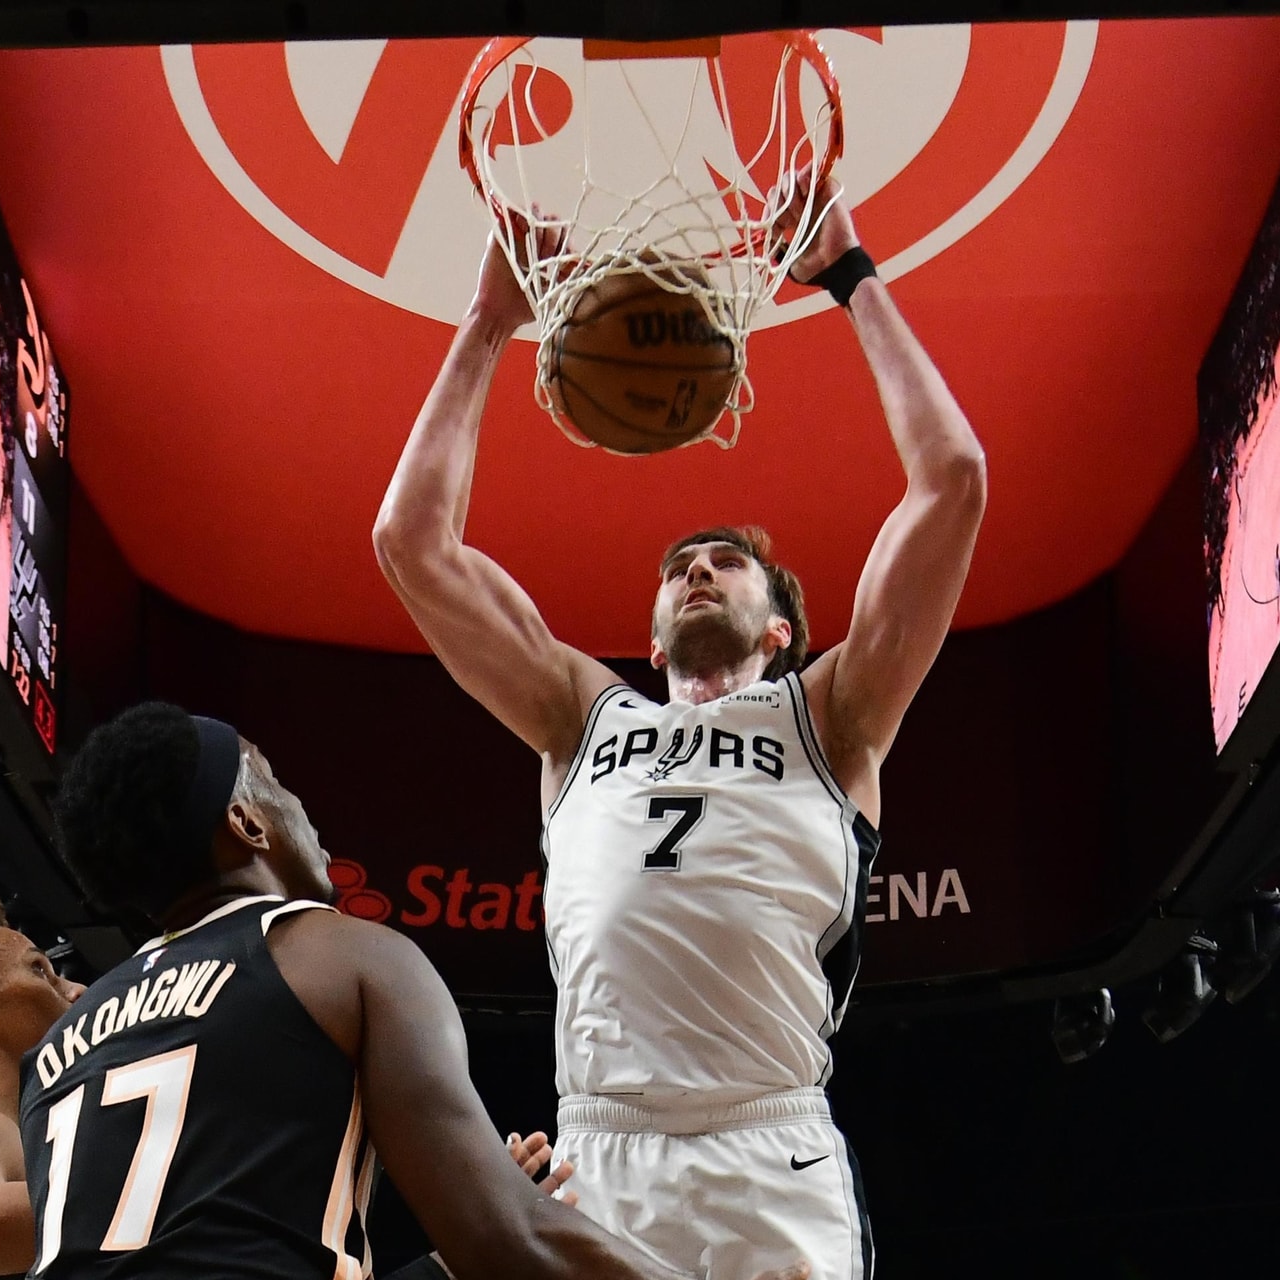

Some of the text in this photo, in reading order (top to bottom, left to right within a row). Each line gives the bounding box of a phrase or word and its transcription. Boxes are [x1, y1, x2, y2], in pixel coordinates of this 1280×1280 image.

[625, 310, 728, 347] Wils
[591, 725, 785, 783] SPURS
[642, 793, 706, 873] 7
[401, 865, 543, 930] Stat
[35, 959, 237, 1089] OKONGWU
[35, 1043, 198, 1275] 17
